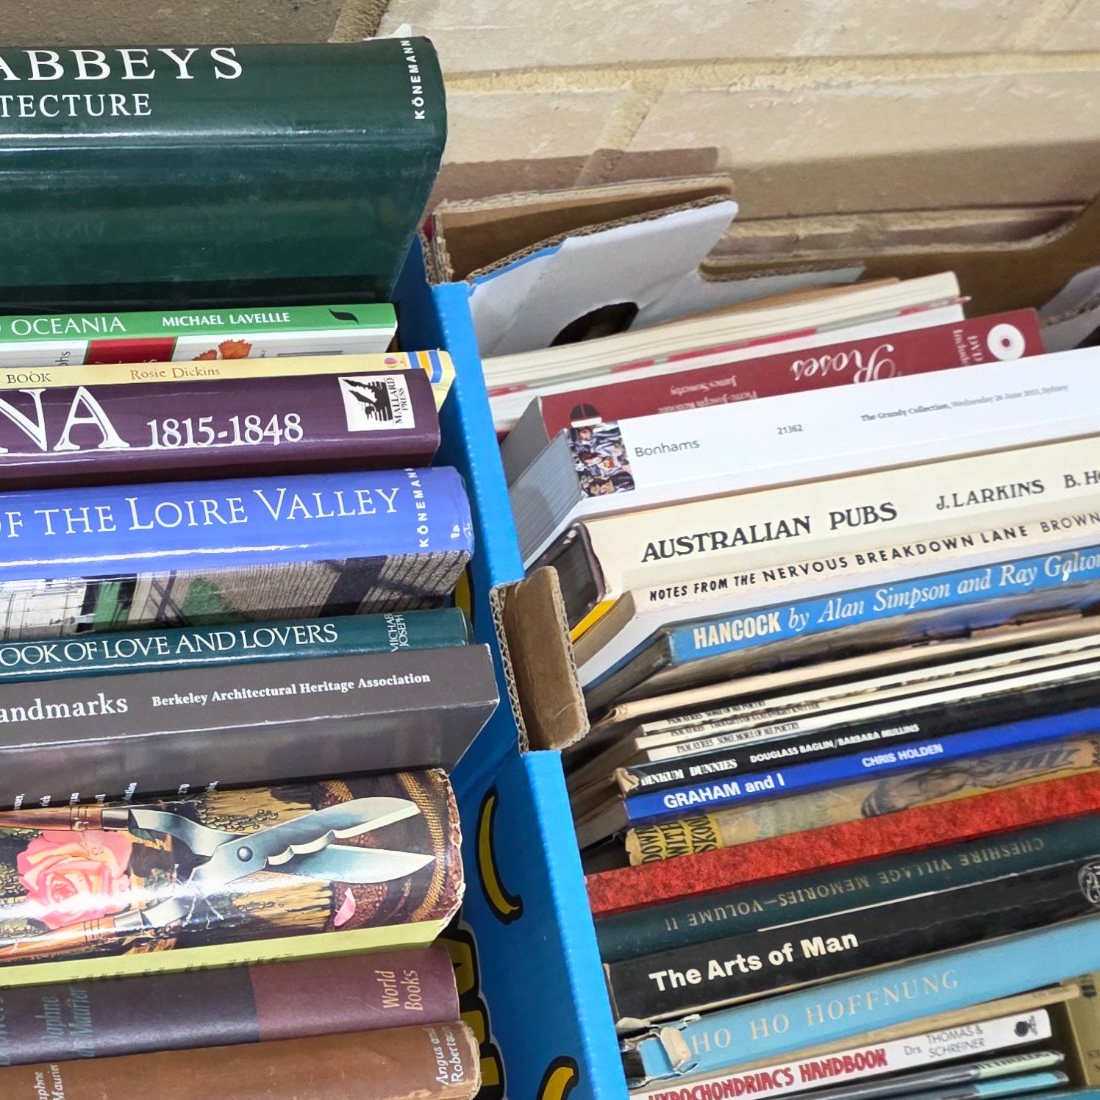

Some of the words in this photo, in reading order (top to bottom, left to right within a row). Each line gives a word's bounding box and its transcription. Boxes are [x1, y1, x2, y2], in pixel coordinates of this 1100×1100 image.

[400, 40, 426, 120] KÖNEMANN
[11, 315, 127, 336] OCEANIA
[162, 313, 225, 328] MICHAEL
[147, 412, 304, 449] 1815-1848
[777, 424, 803, 434] 21362
[635, 438, 700, 458] Bonhams
[36, 504, 116, 536] THE
[125, 495, 247, 532] LOIRE
[254, 486, 400, 522] VALLEY
[641, 516, 811, 563] AUSTRALIAN
[829, 502, 897, 530] PUBS
[936, 479, 1044, 511] J.LARKINS
[650, 584, 687, 600] NOTES
[695, 577, 727, 594] FROM
[734, 573, 756, 586] THE
[764, 556, 848, 582] NERVOUS
[856, 533, 974, 566] BREAKDOWN
[981, 524, 1028, 545] LANE
[694, 612, 781, 649] HANCOCK
[788, 608, 810, 632] by
[819, 596, 864, 623] Alan
[873, 581, 950, 613] Simpson
[957, 567, 991, 595] and
[1000, 562, 1038, 590] Ray
[64, 641, 98, 662] OF
[103, 635, 170, 659] LOVE
[176, 631, 236, 653] AND
[241, 623, 339, 649] LOVERS
[152, 693, 208, 708] Berkeley
[211, 683, 297, 701] Architectural
[300, 680, 355, 696] Heritage
[358, 672, 431, 688] Association
[862, 752, 896, 768] CHRIS
[899, 743, 943, 761] HOLDEN
[663, 781, 741, 809] GRAHAM
[746, 775, 774, 793] and
[649, 967, 702, 993] The
[707, 953, 762, 981] Arts
[768, 943, 793, 967] of
[800, 932, 858, 959] Man
[690, 1028, 731, 1054] HO
[750, 1014, 790, 1039] HO
[805, 968, 959, 1027] HOFFNUNG
[800, 1049, 888, 1083] HANDBOOK
